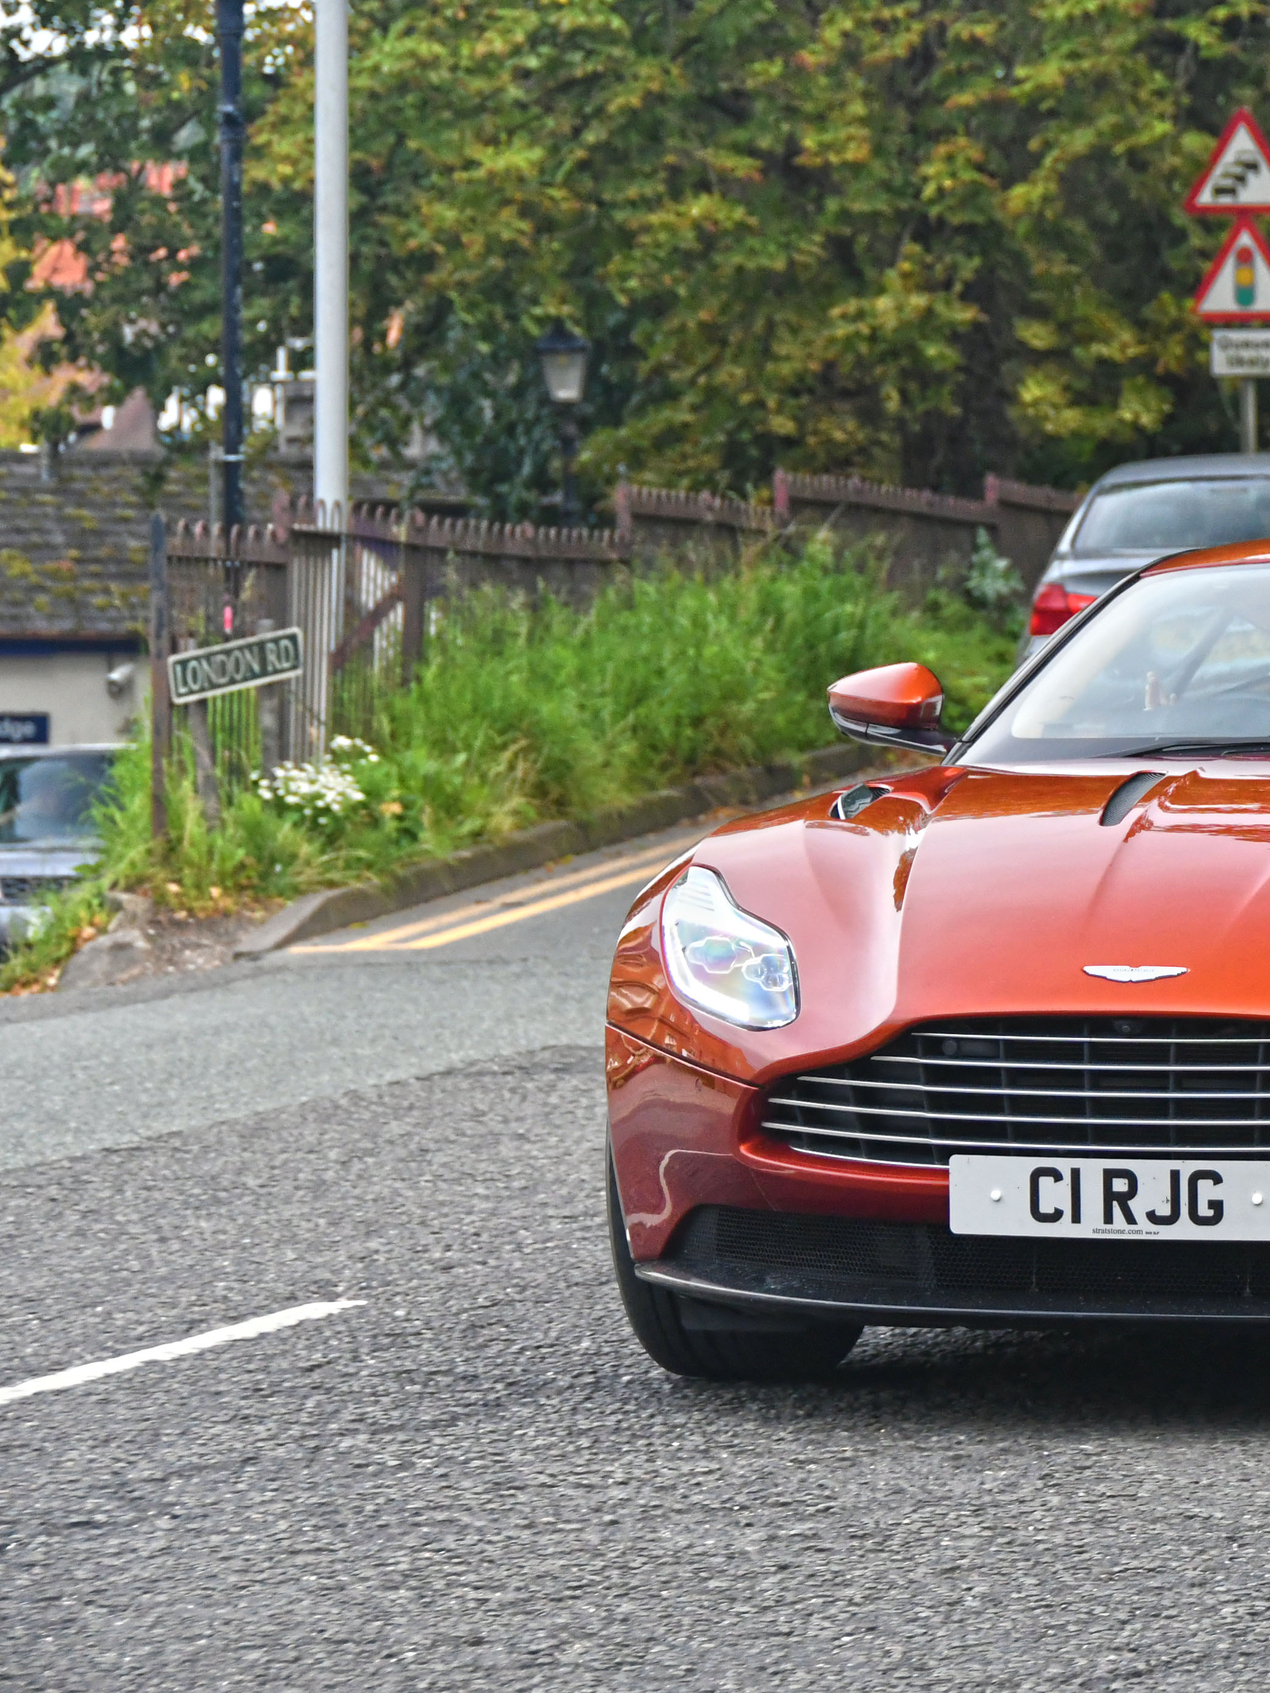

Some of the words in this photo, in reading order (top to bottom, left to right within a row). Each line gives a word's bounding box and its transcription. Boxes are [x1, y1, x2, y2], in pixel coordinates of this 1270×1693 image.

[174, 644, 261, 695] LONDON
[1102, 1167, 1225, 1227] RJG
[1092, 1227, 1144, 1236] stratstone.com
